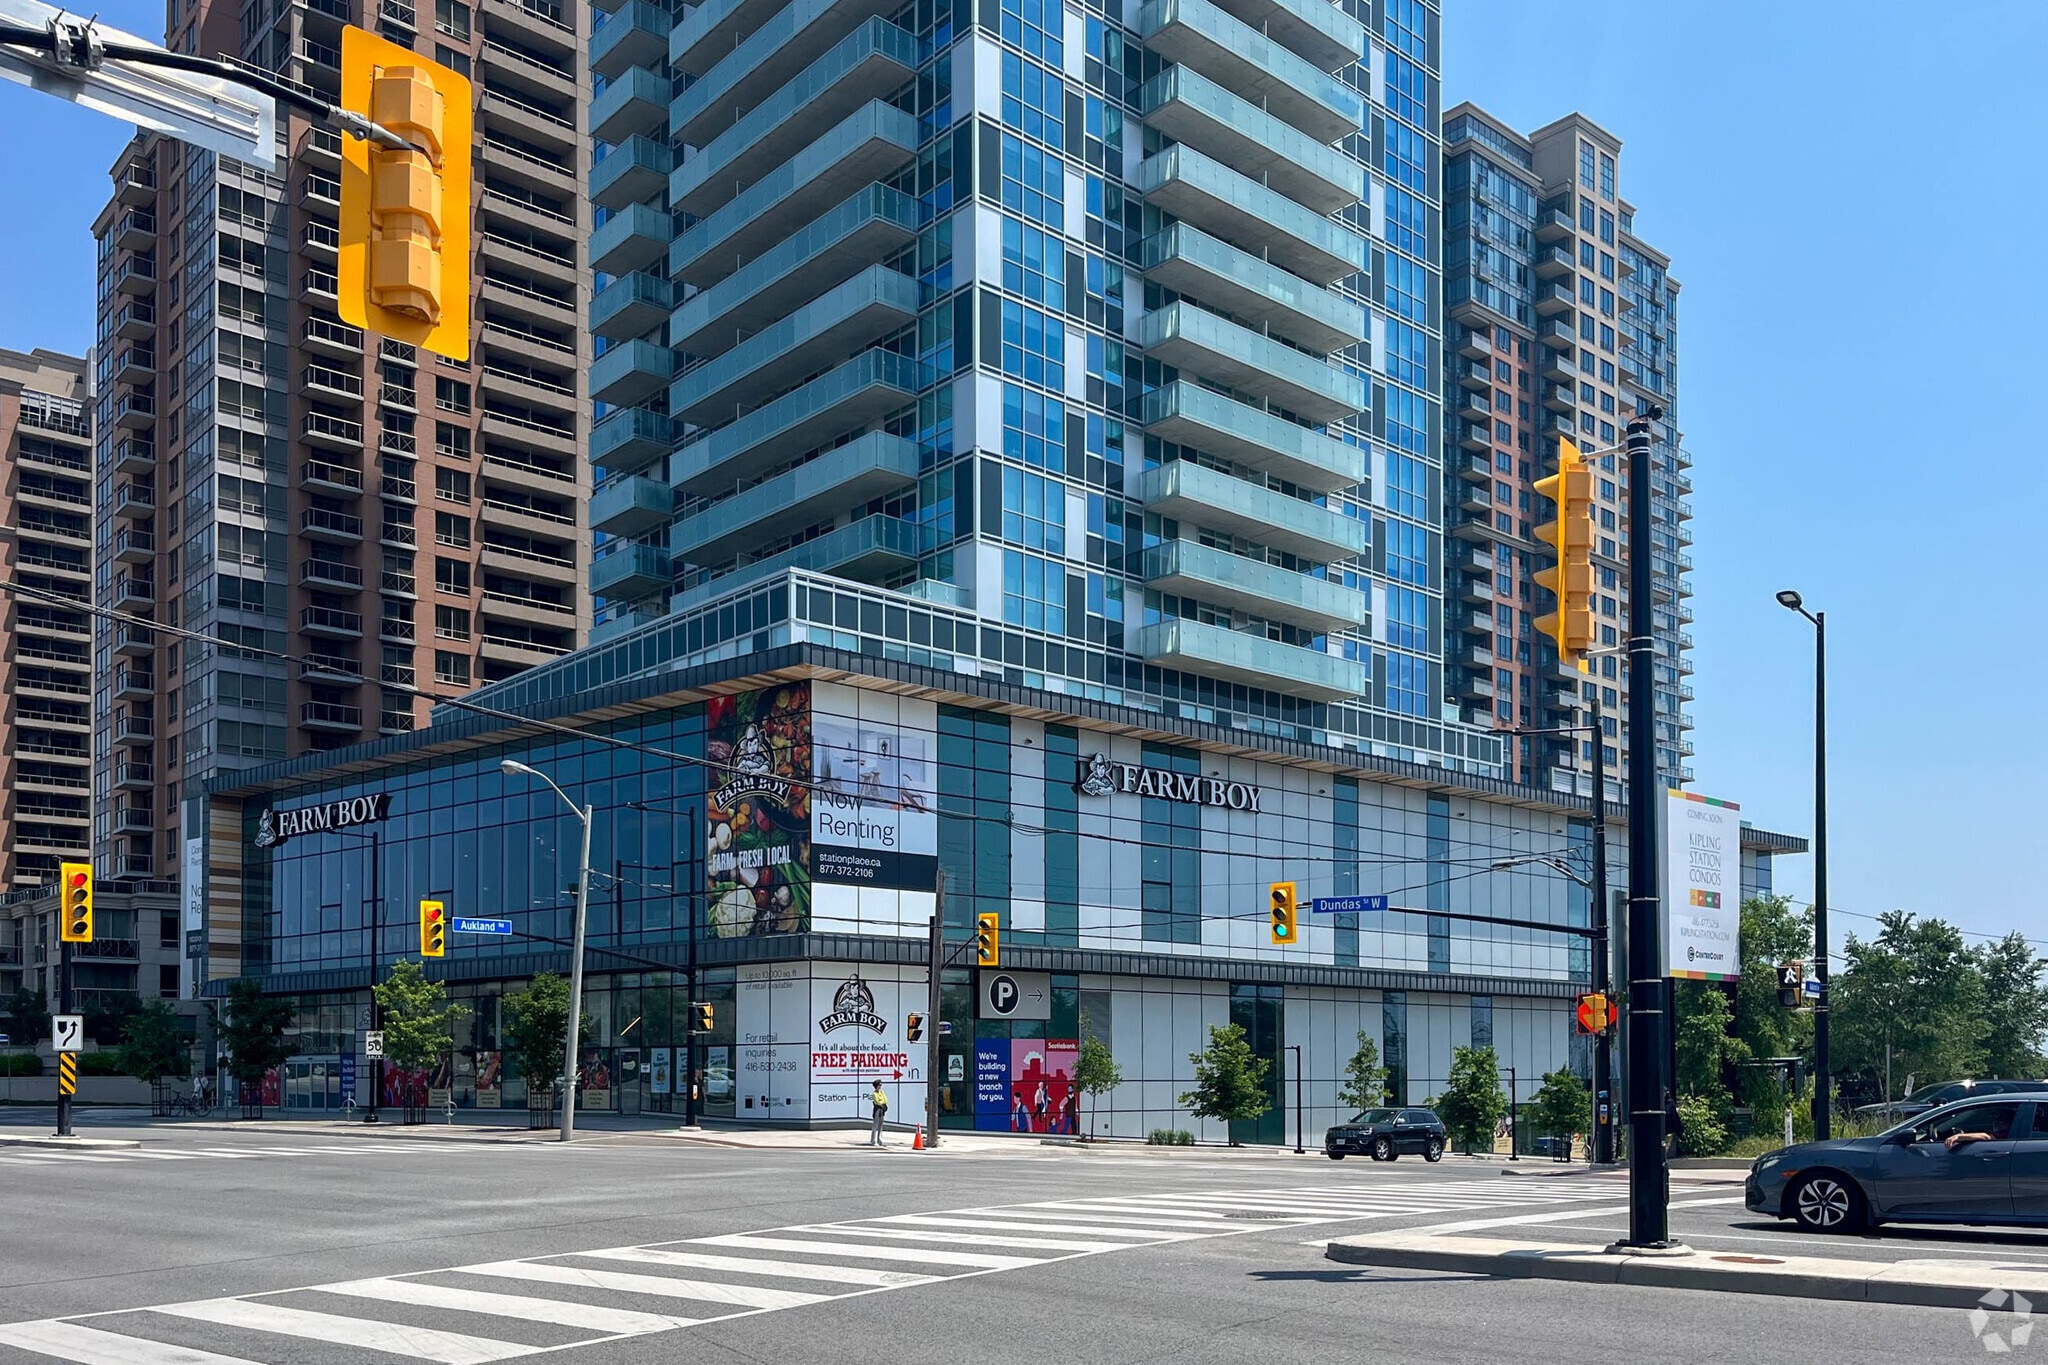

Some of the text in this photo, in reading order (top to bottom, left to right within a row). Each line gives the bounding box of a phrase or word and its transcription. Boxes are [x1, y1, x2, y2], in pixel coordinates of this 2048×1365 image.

[716, 777, 788, 807] FARM BOY
[1121, 764, 1262, 812] FARM BOY
[819, 787, 863, 810] Now
[278, 794, 381, 837] FARM BOY
[819, 812, 895, 847] Renting
[1689, 832, 1721, 850] KIPLING
[712, 844, 792, 872] FARM FRESH LOCAL
[819, 852, 882, 868] stationplace.ca
[1689, 850, 1721, 869] STATION
[819, 864, 874, 878] 877-372-2106
[1689, 868, 1721, 887] CONDOS
[1320, 899, 1361, 911] Dundas
[1371, 897, 1381, 909] W
[460, 920, 496, 932] Aukland
[998, 981, 1013, 1008] P
[821, 1012, 886, 1031] FARM BOY
[745, 1032, 778, 1042] For retail
[368, 1040, 382, 1052] 50
[818, 1043, 828, 1051] It's
[830, 1043, 838, 1051] all
[839, 1043, 858, 1051] about
[859, 1043, 870, 1051] the
[1047, 1041, 1076, 1050] Scotiabank
[745, 1047, 777, 1059] inquiries
[812, 1053, 908, 1067] FREE PARKING
[978, 1052, 998, 1060] We're
[745, 1061, 797, 1072] 416-530-2438
[978, 1062, 1006, 1072] building
[978, 1082, 1003, 1091] branch
[818, 1093, 847, 1102] Station
[978, 1093, 1004, 1103] for you.
